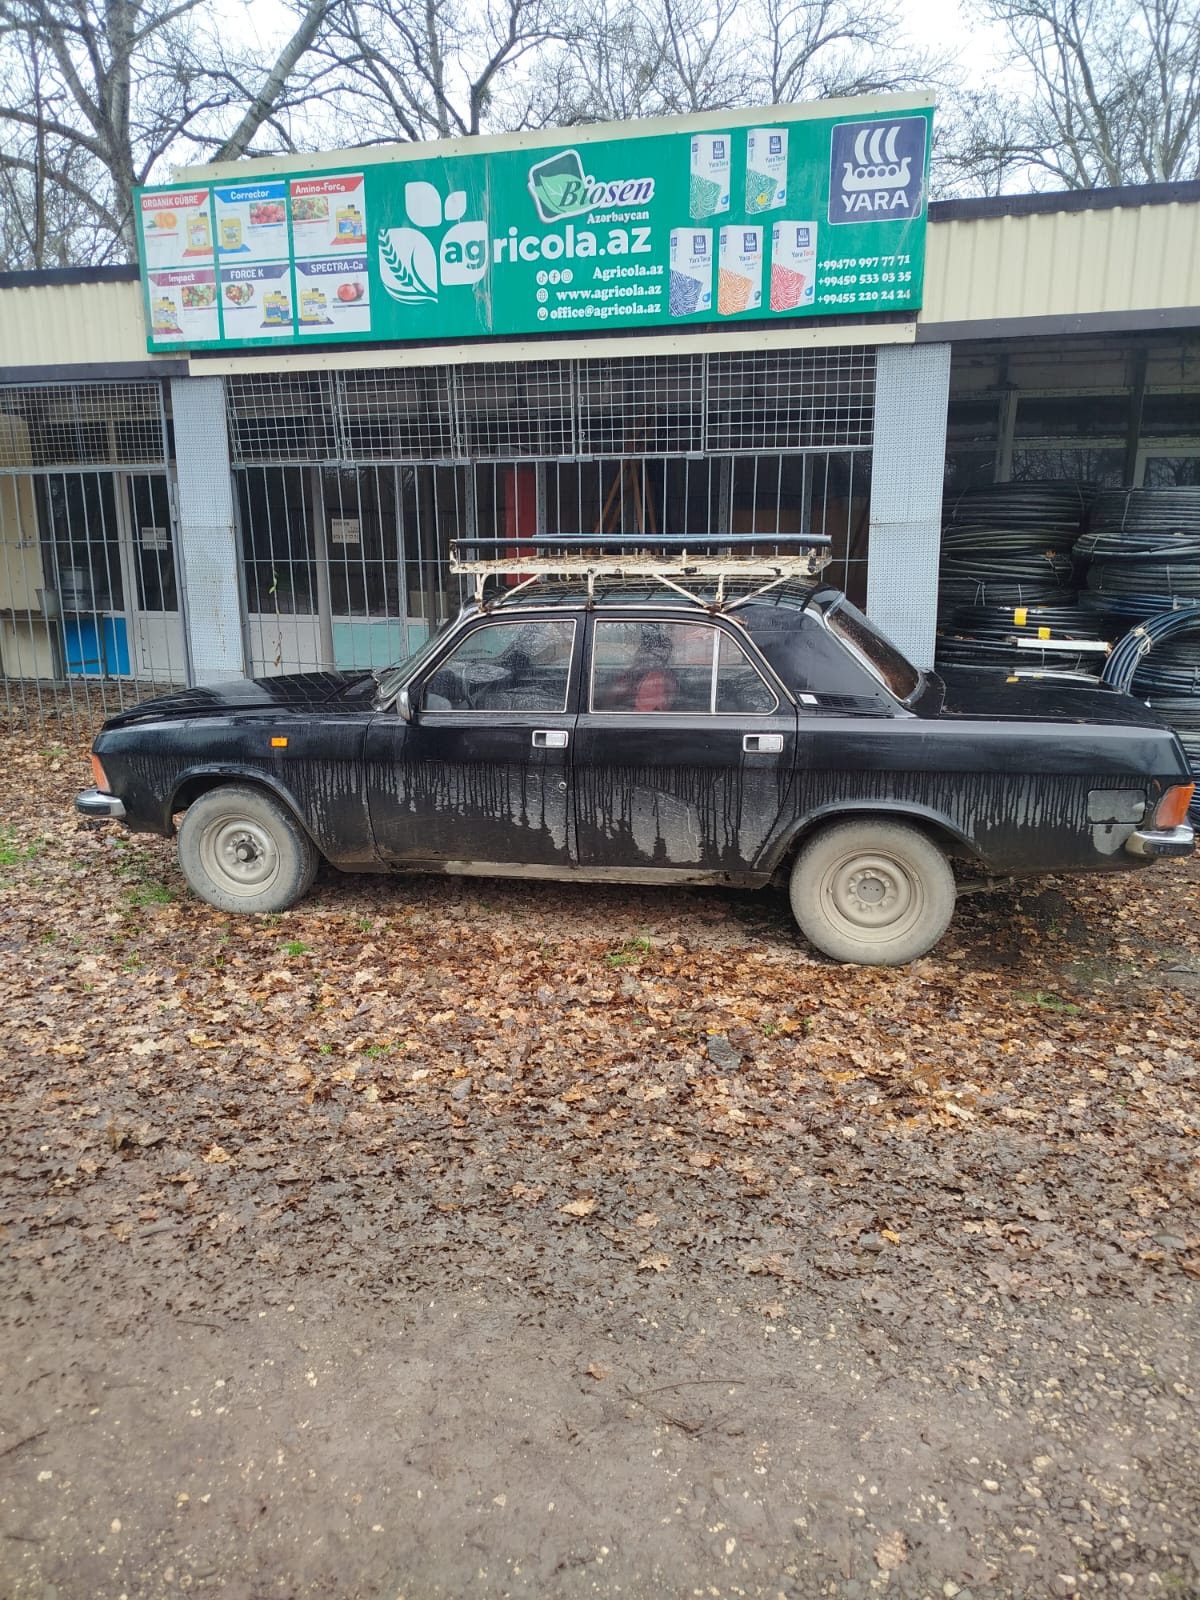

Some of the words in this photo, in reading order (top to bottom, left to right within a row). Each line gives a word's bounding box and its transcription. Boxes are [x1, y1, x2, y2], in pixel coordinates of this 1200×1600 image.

[230, 189, 270, 200] Corrector
[559, 176, 652, 207] Biosen
[841, 190, 910, 213] YARA
[444, 225, 652, 270] agricola.az
[310, 261, 364, 273] SPECTRA-Ca
[817, 258, 857, 270] +99470
[858, 256, 879, 268] 997
[882, 256, 895, 266] 77
[897, 254, 911, 266] 71
[168, 272, 195, 284] Impact
[230, 270, 256, 280] FORCE
[258, 269, 264, 278] K
[592, 264, 664, 281] Agricola.az
[817, 274, 857, 287] +99450
[859, 274, 879, 284] 533
[882, 272, 895, 282] 03
[897, 271, 912, 282] 35
[556, 284, 662, 301] www.agricola.az
[817, 292, 856, 304] +99455
[858, 291, 878, 301] 220
[880, 290, 895, 300] 24
[896, 288, 911, 300] 24
[550, 302, 662, 319] office@agricola.az
